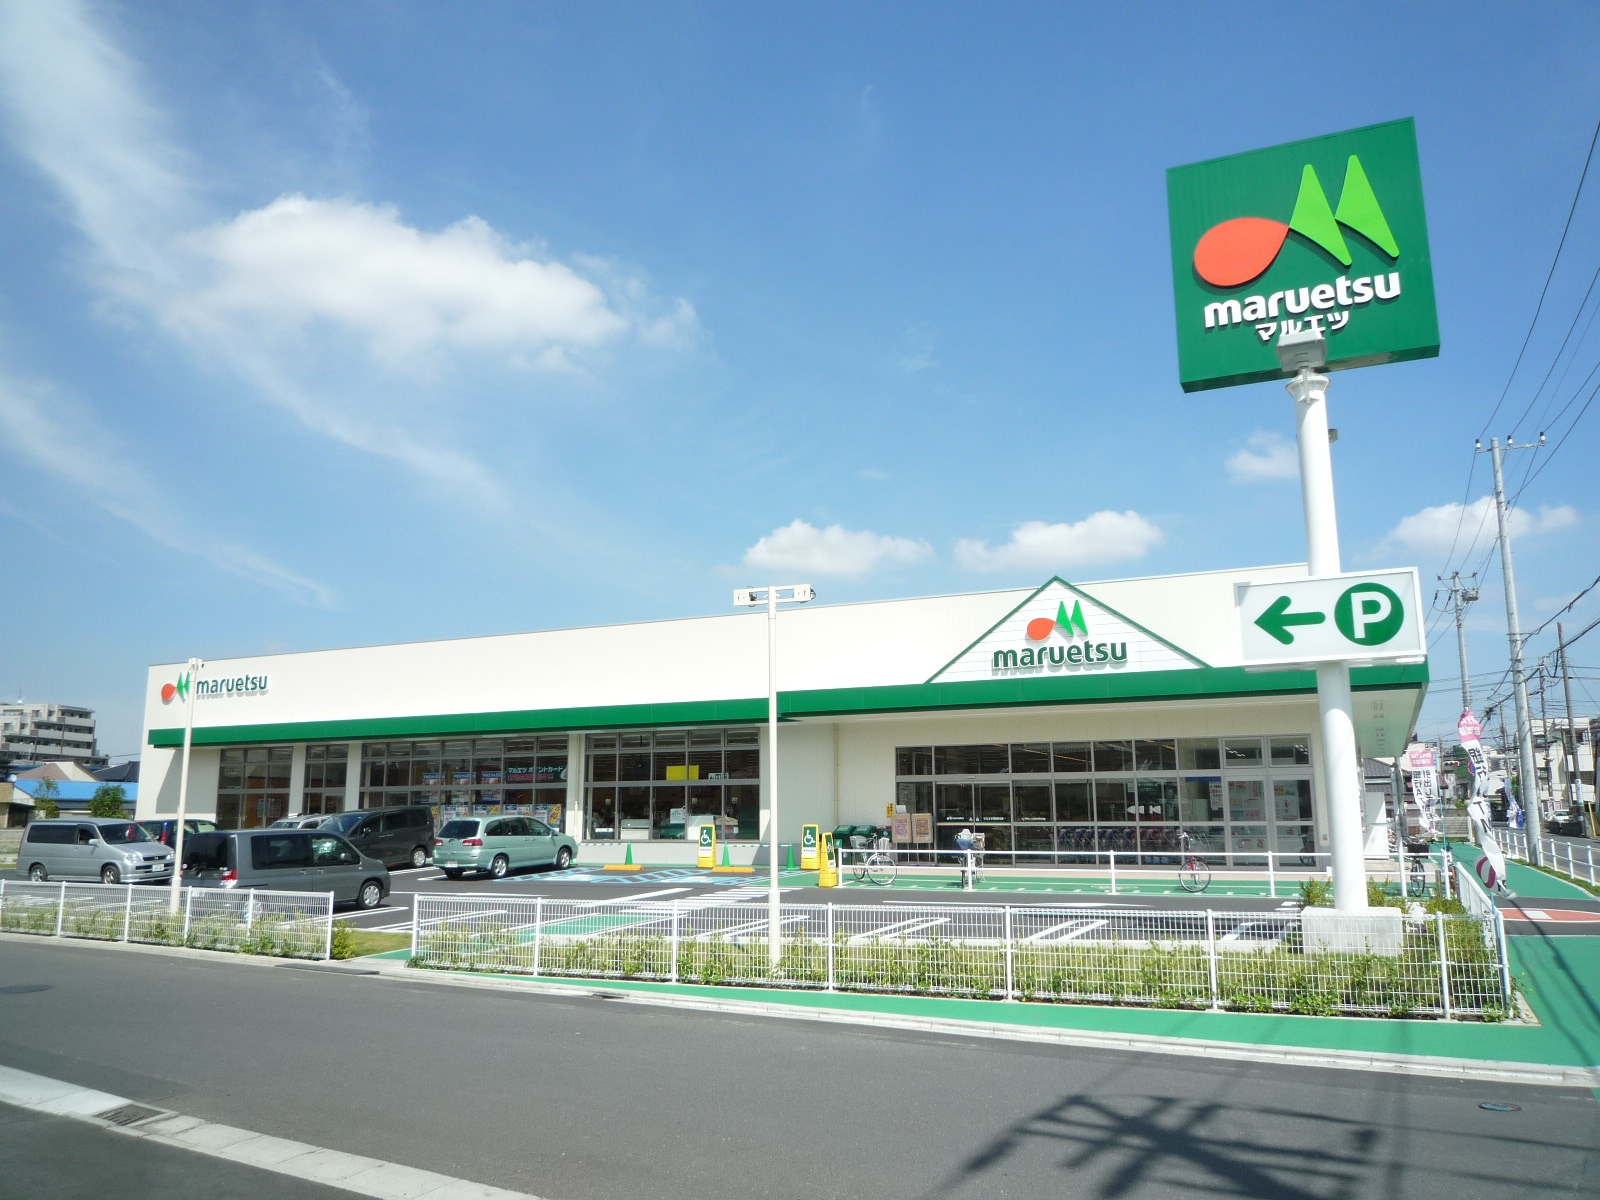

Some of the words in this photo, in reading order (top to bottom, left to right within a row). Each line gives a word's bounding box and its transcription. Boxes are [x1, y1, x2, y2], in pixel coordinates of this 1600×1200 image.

[1204, 272, 1401, 328] maruetsu
[1255, 311, 1350, 341] マルエツ
[1351, 591, 1392, 639] P
[993, 640, 1128, 669] maruetsu
[196, 674, 268, 695] maruetsu
[528, 765, 563, 773] ポントカード
